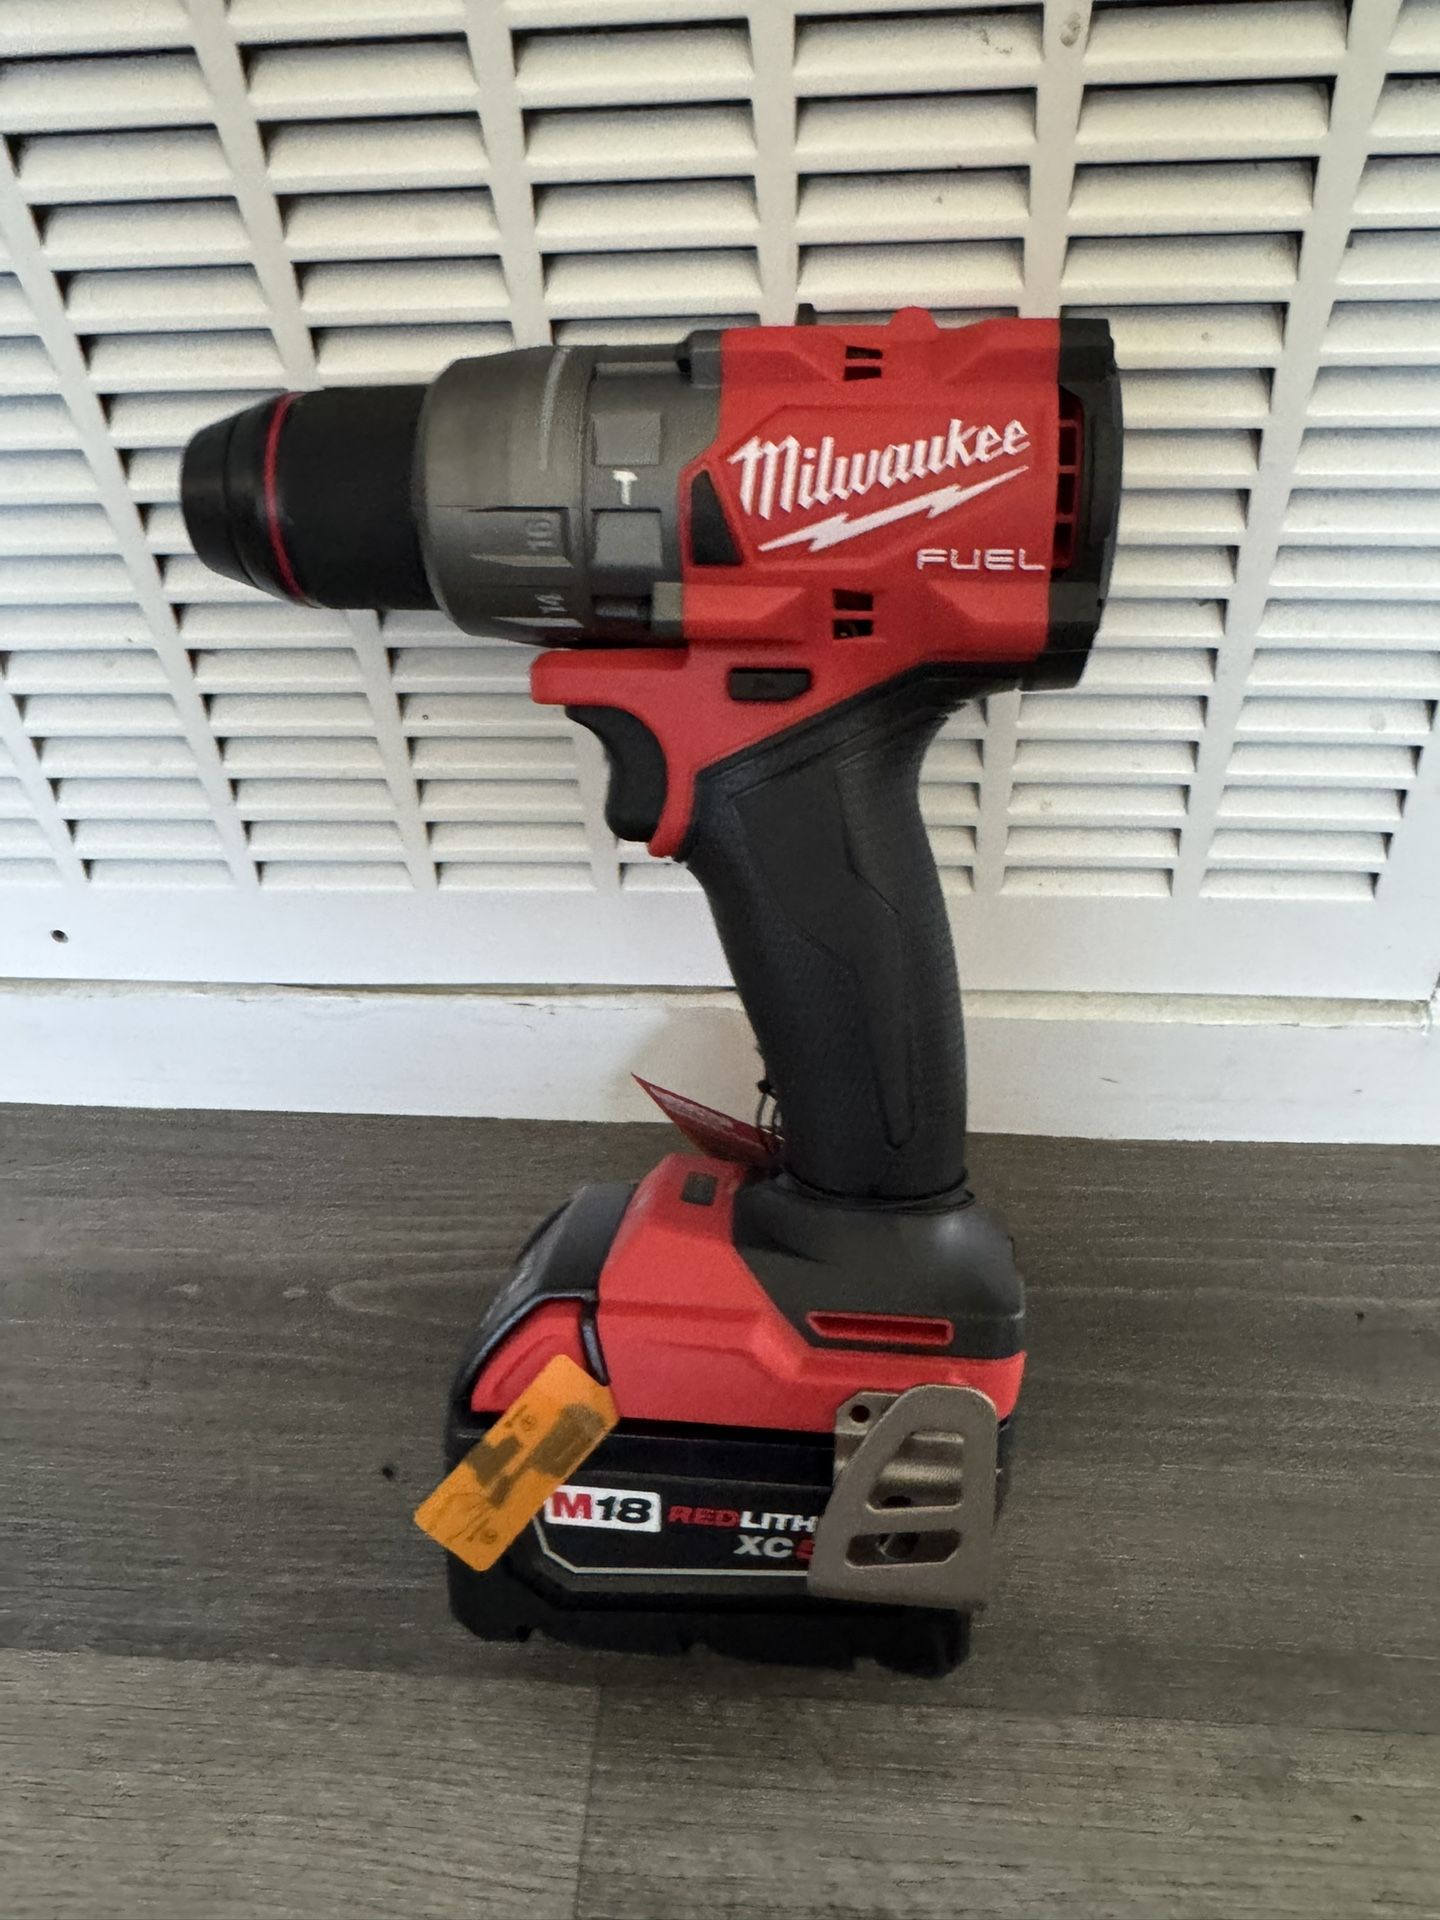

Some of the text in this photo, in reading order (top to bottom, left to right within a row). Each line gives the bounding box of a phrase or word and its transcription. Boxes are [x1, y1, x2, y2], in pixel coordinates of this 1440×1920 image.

[727, 418, 1031, 520] Milwaukee
[917, 548, 1047, 571] FUEL
[552, 1491, 652, 1524] M18
